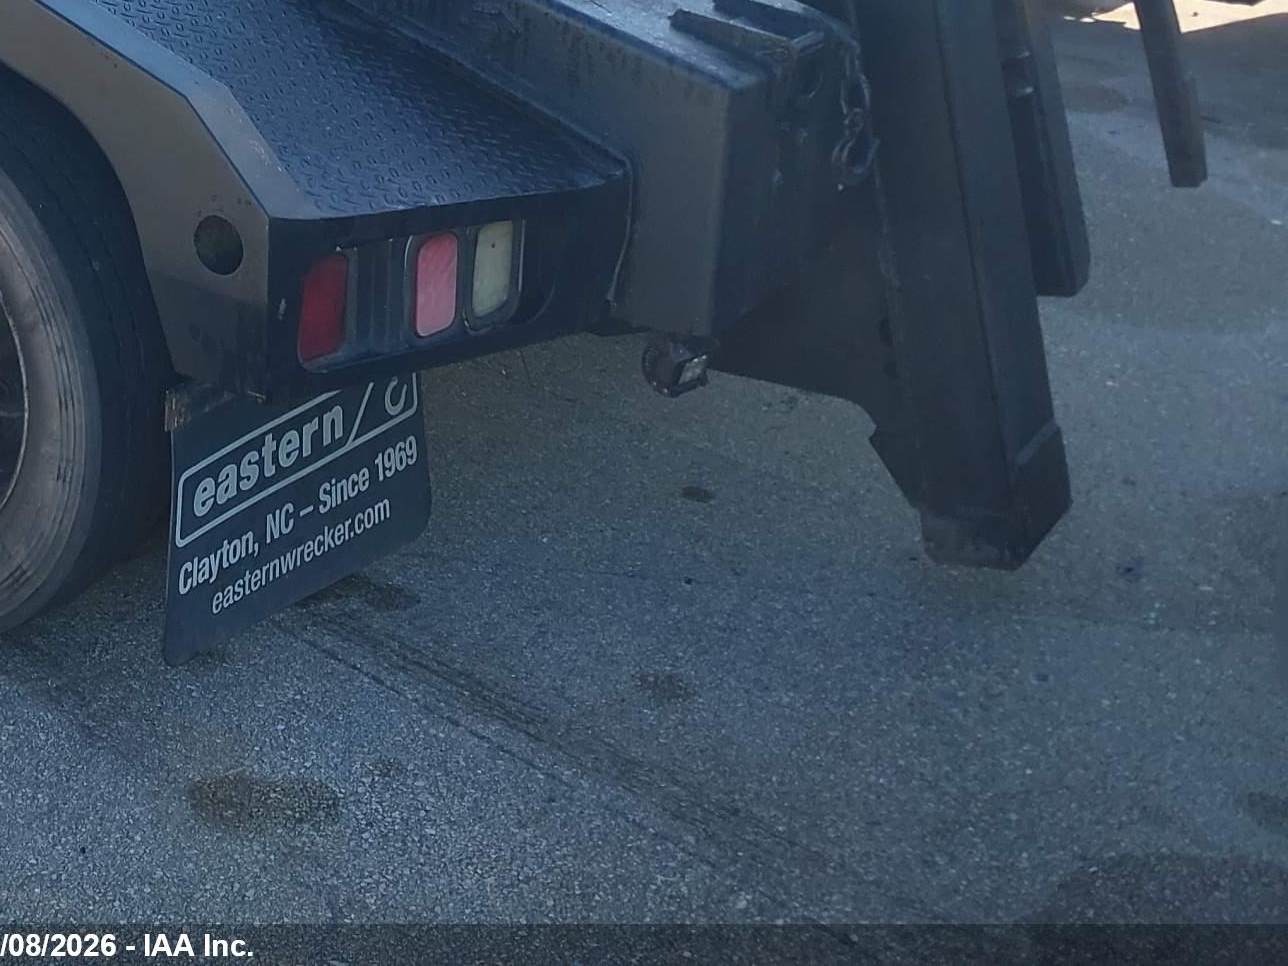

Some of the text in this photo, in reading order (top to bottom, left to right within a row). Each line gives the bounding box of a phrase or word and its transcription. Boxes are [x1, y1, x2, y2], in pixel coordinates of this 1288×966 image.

[178, 531, 259, 595] Clayton,
[266, 503, 295, 544] NC
[318, 467, 370, 514] Since
[375, 435, 418, 482] 1969
[193, 404, 344, 518] eastern
[212, 498, 391, 615] easternwrecker.com
